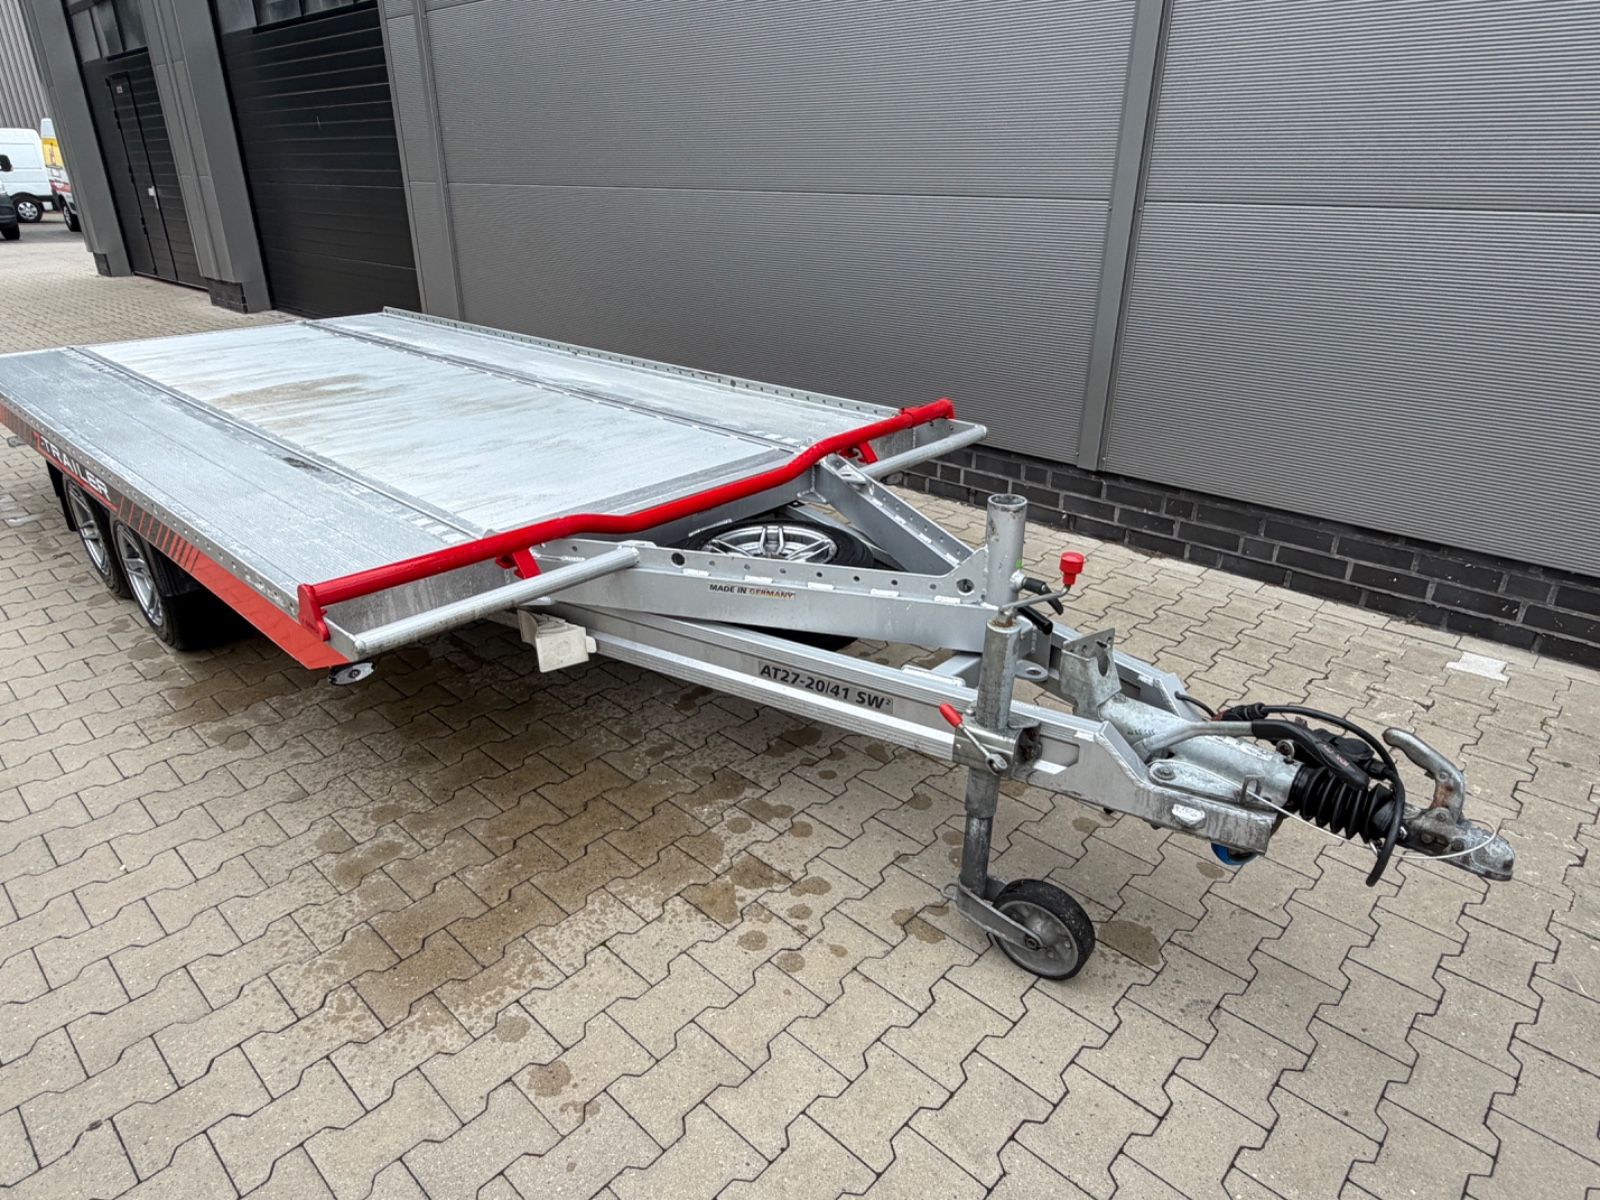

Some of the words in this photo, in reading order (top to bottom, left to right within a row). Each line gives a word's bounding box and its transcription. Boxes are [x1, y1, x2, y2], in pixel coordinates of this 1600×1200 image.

[709, 584, 735, 594] MADE
[737, 586, 747, 595] IN
[749, 587, 796, 599] GERMANY
